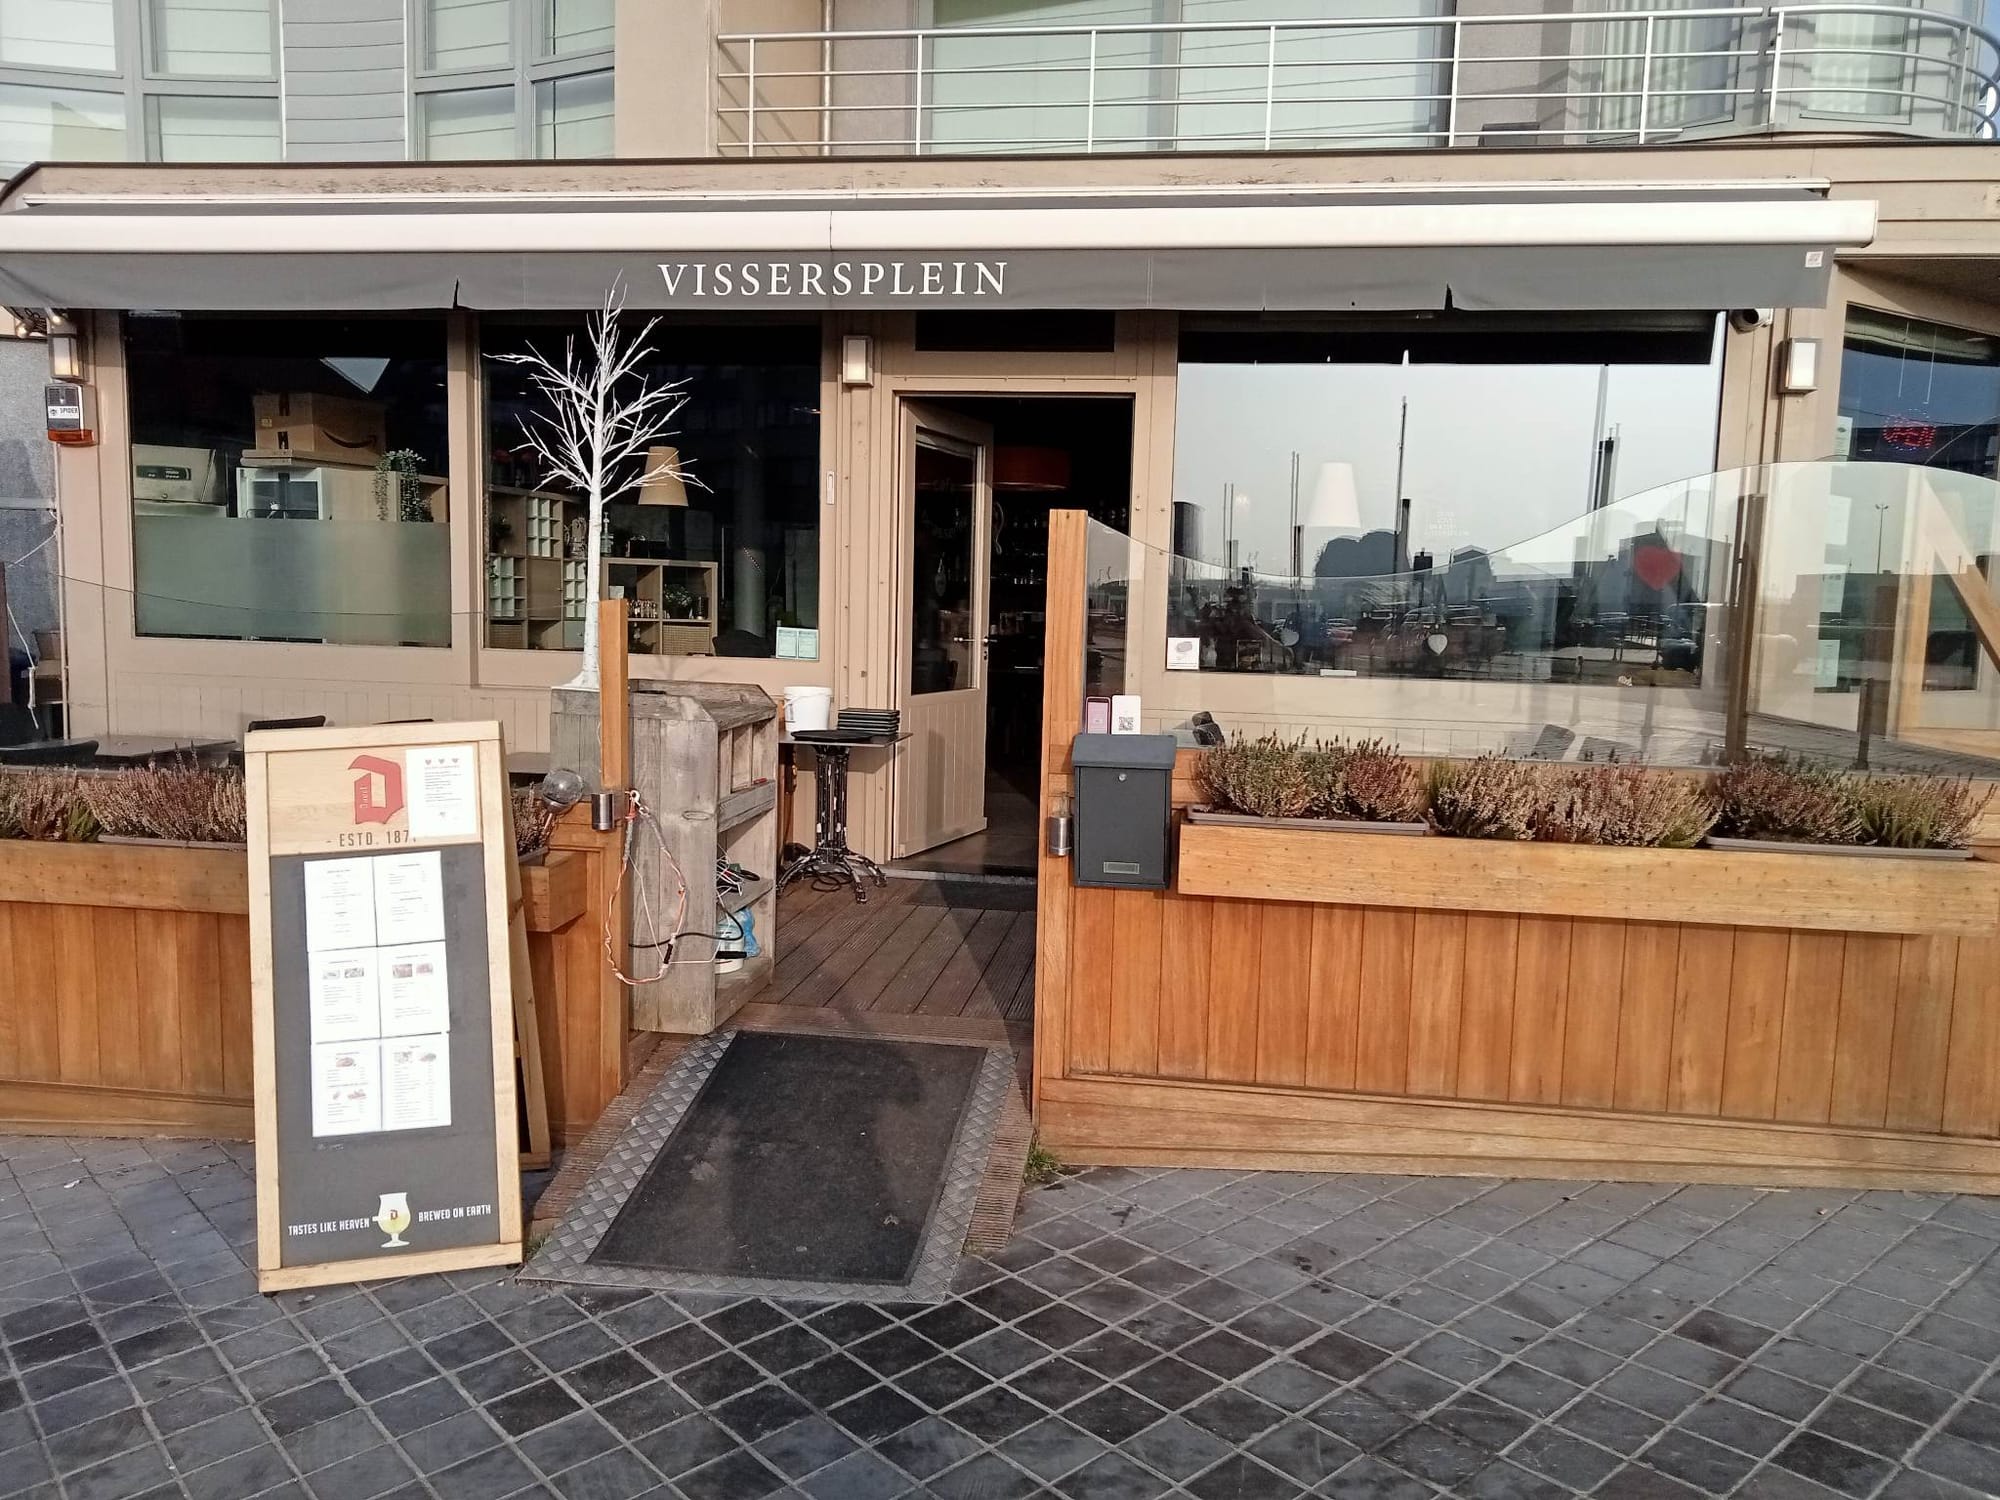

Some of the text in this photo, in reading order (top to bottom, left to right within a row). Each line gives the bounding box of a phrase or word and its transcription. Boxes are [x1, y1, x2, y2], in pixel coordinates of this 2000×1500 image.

[657, 261, 1008, 297] VISSERSPLEIN
[386, 829, 417, 845] 187
[418, 1204, 491, 1223] BREWED ON EARTH
[288, 1217, 370, 1236] TASTES LIKE HEAVEN
